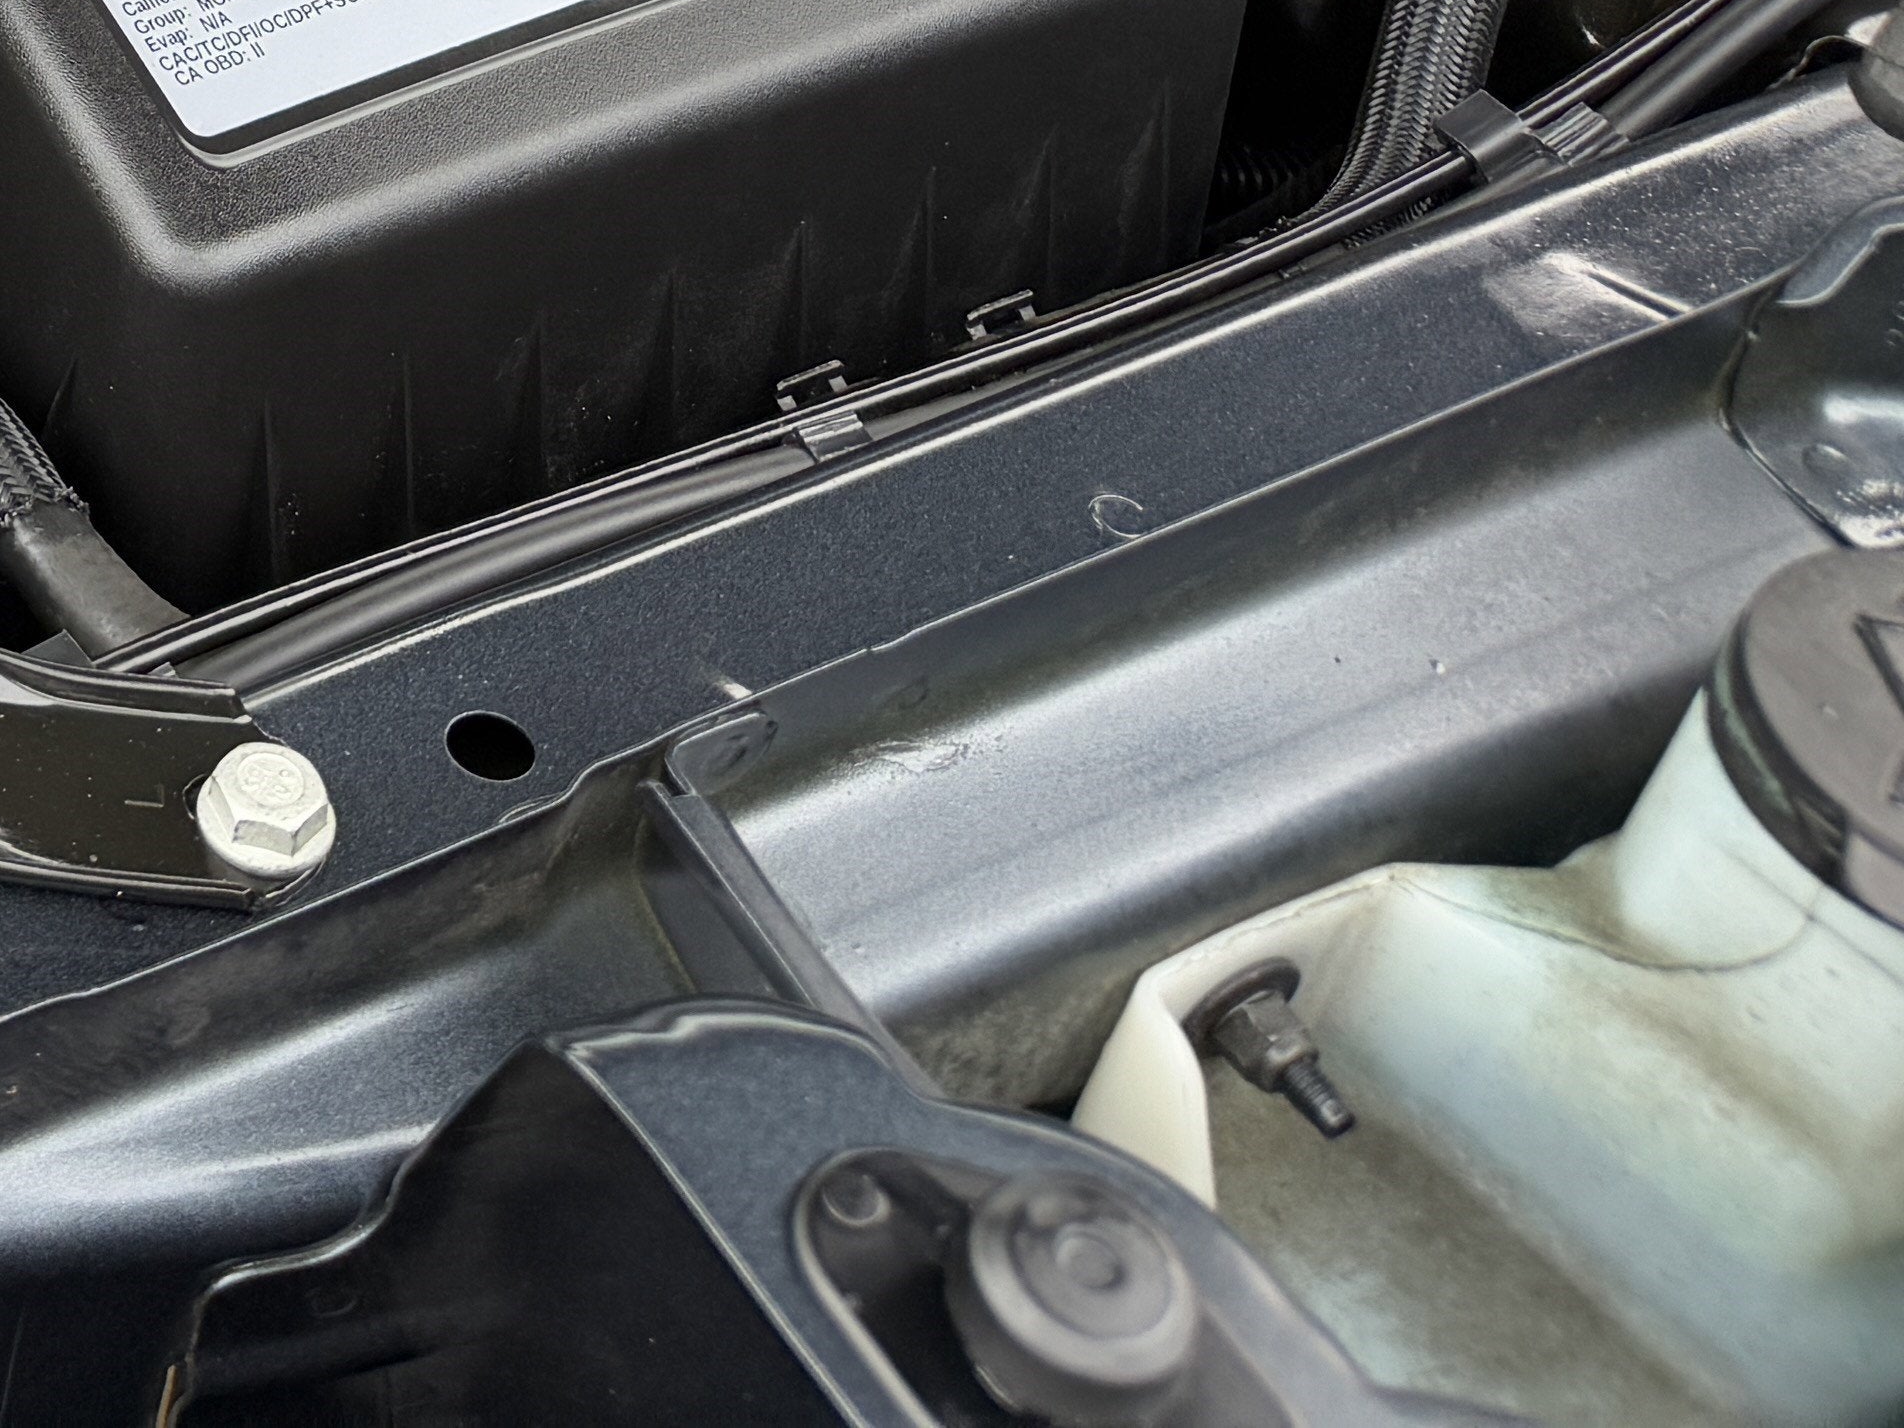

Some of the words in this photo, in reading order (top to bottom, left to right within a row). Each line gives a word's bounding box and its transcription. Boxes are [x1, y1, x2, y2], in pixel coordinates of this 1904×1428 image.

[134, 7, 191, 33] Group:
[145, 28, 193, 52] Evap:
[199, 11, 232, 32] N/A
[175, 67, 203, 85] CA
[204, 51, 250, 74] OBD:
